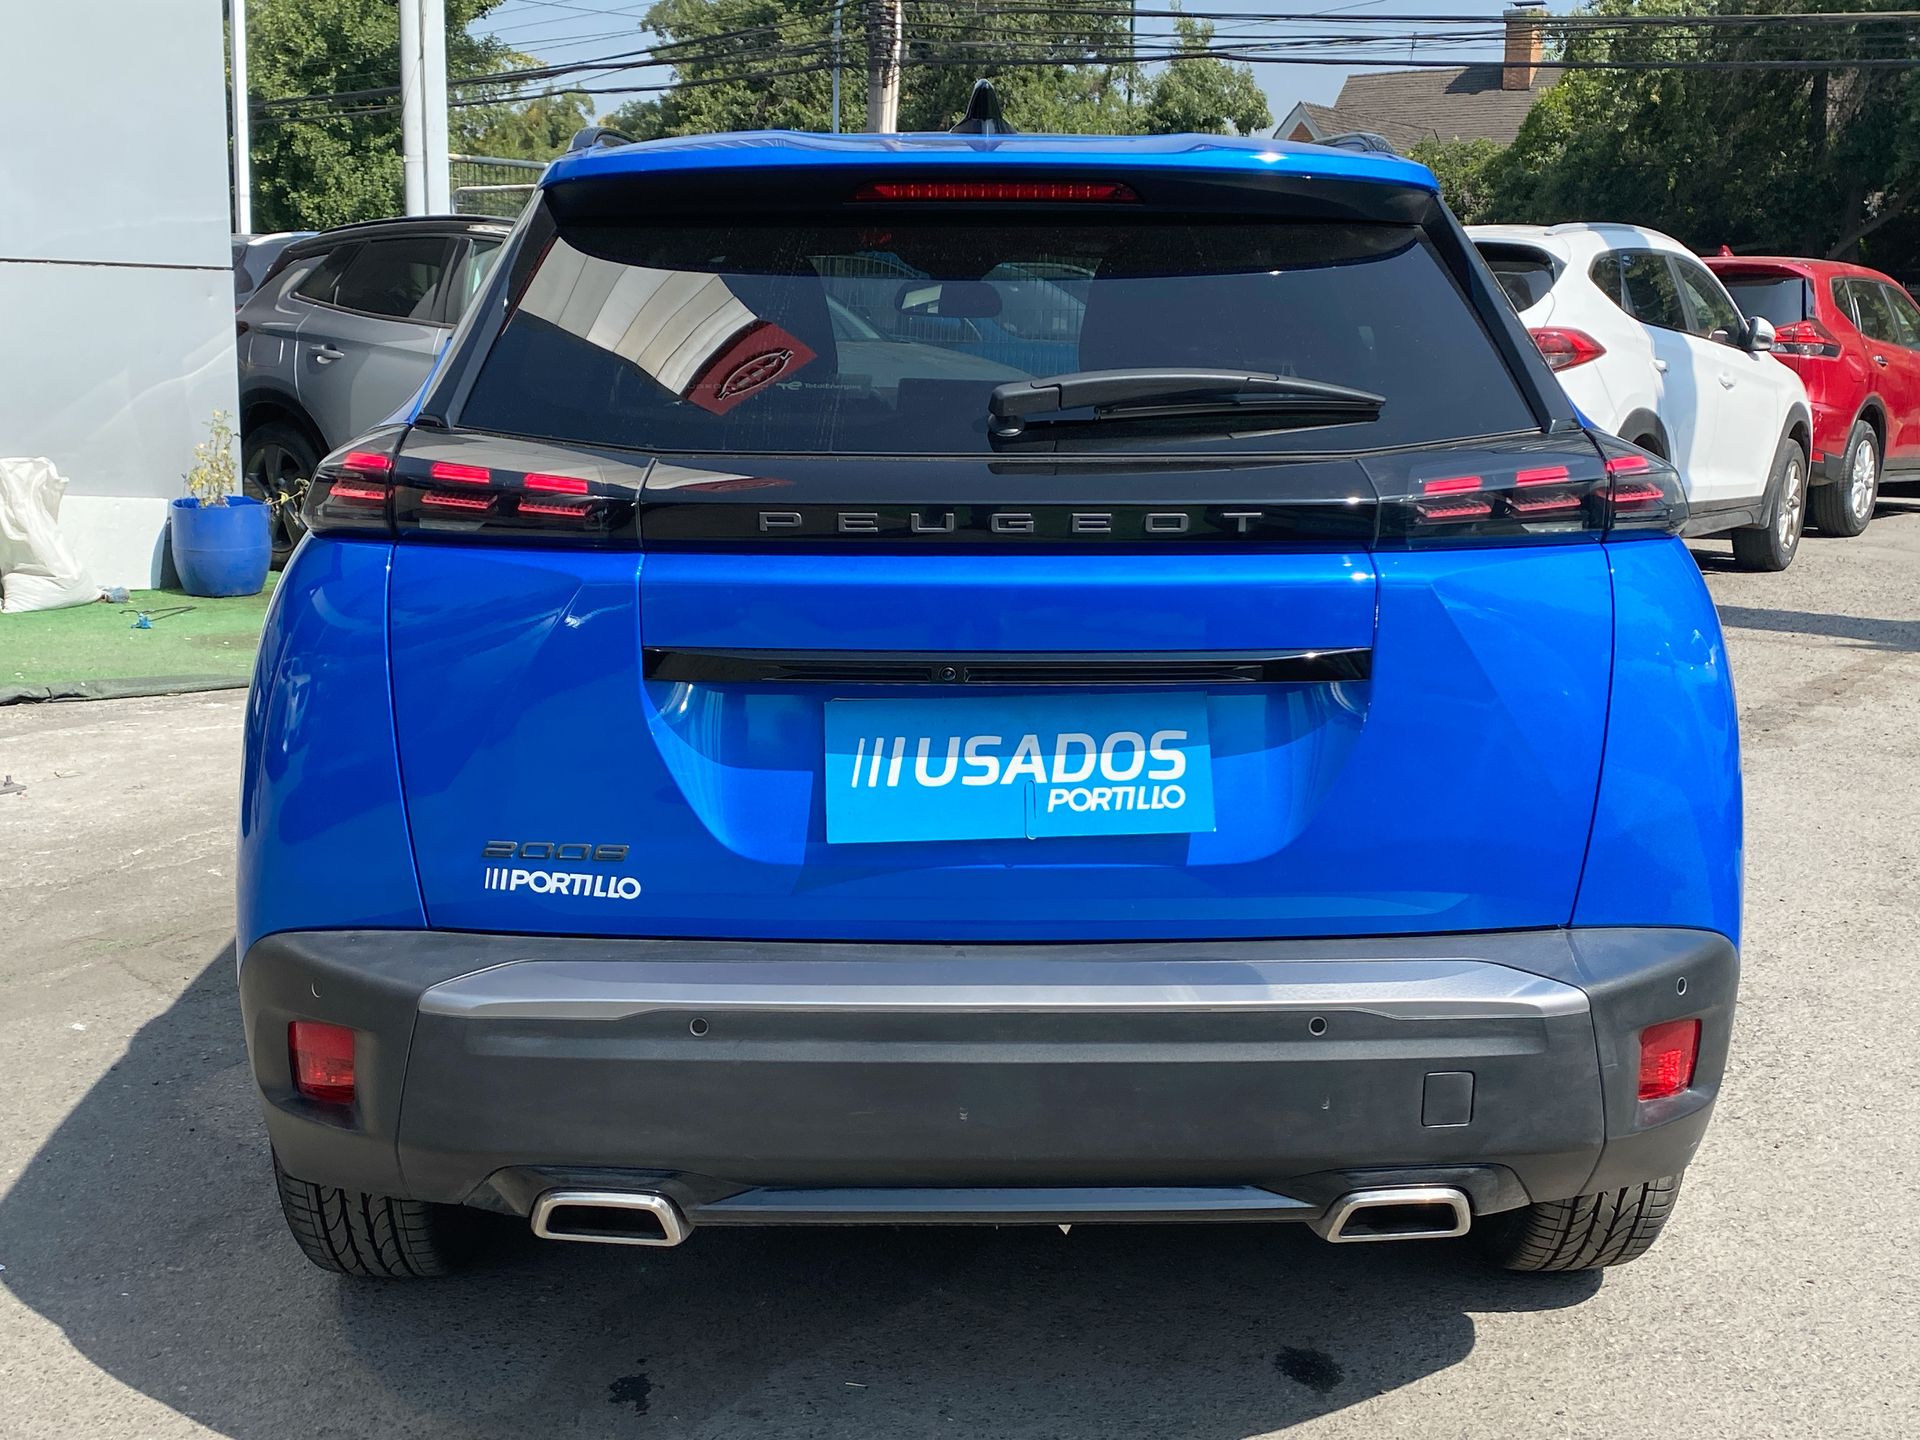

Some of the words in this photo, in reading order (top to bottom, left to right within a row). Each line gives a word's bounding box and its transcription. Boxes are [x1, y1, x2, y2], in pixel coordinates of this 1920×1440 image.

[758, 511, 1263, 534] PEUGEOT
[914, 729, 1188, 788] USADOS
[1047, 784, 1187, 814] PORTILLO
[482, 840, 630, 861] 2008
[509, 868, 642, 900] PORTILLO
